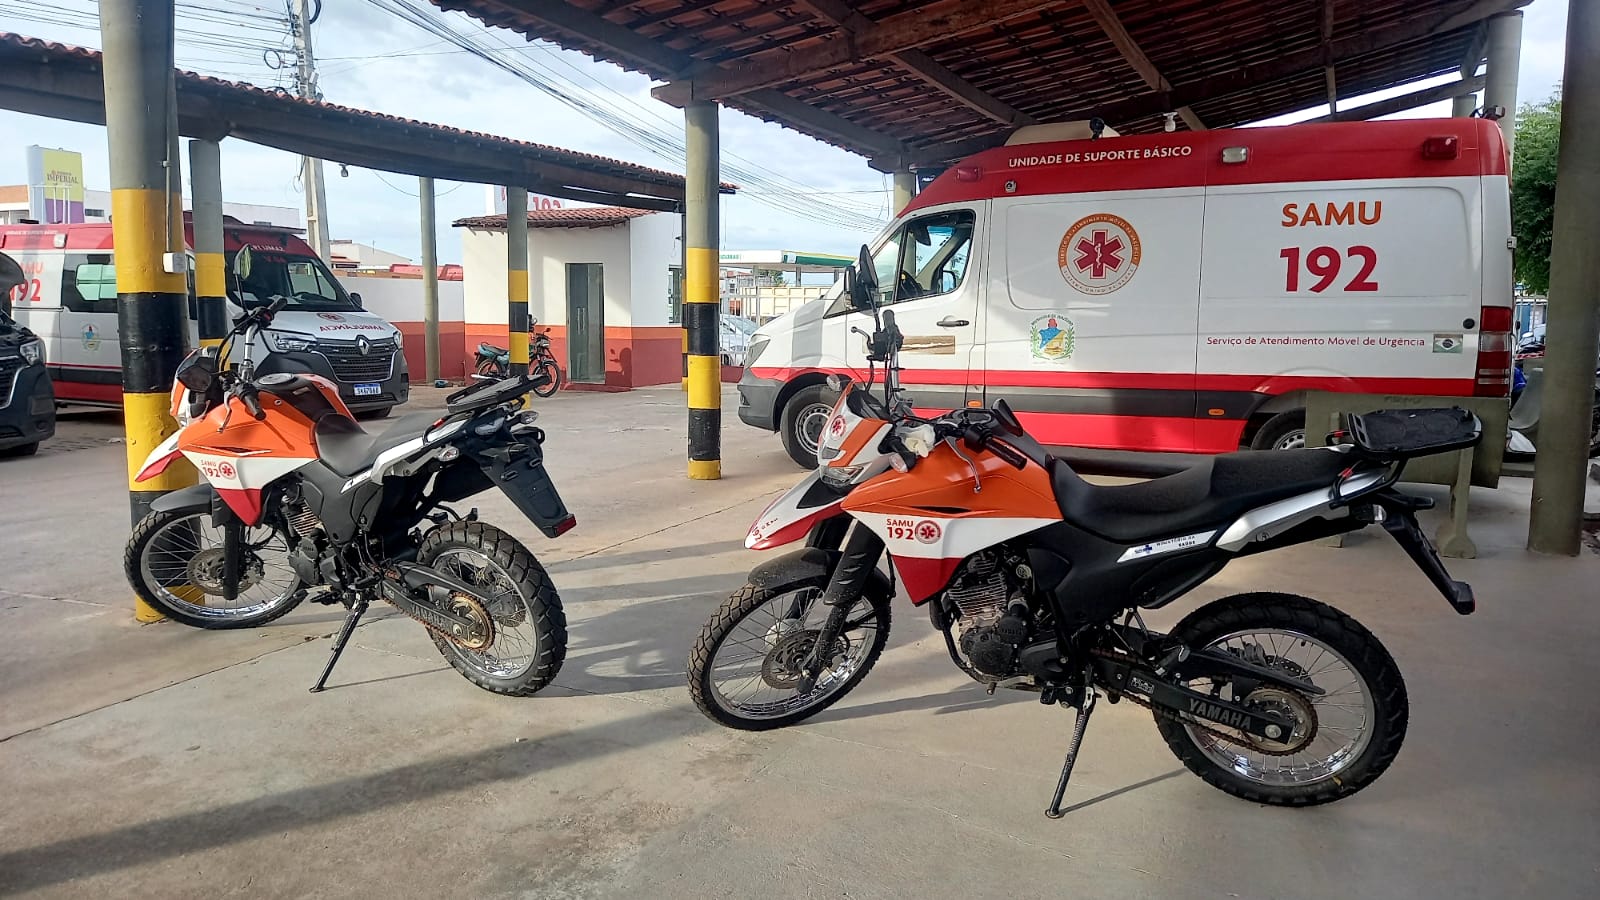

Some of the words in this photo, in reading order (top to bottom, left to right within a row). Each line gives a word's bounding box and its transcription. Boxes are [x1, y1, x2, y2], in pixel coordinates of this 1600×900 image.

[1009, 154, 1062, 168] UNIDADE
[1065, 153, 1081, 163] DE
[1083, 149, 1140, 162] SUPORTE
[1143, 145, 1192, 158] BÁSICO
[1281, 201, 1382, 227] SAMU
[1280, 245, 1379, 293] 192
[1206, 336, 1242, 346] Serviço
[1244, 336, 1257, 345] de
[1259, 336, 1325, 346] Atendimento
[1362, 337, 1376, 346] de
[1379, 336, 1425, 348] Urgência
[202, 467, 221, 477] 192
[887, 518, 914, 527] SAMU
[887, 526, 915, 540] 192
[1189, 698, 1251, 730] YAMAHA
